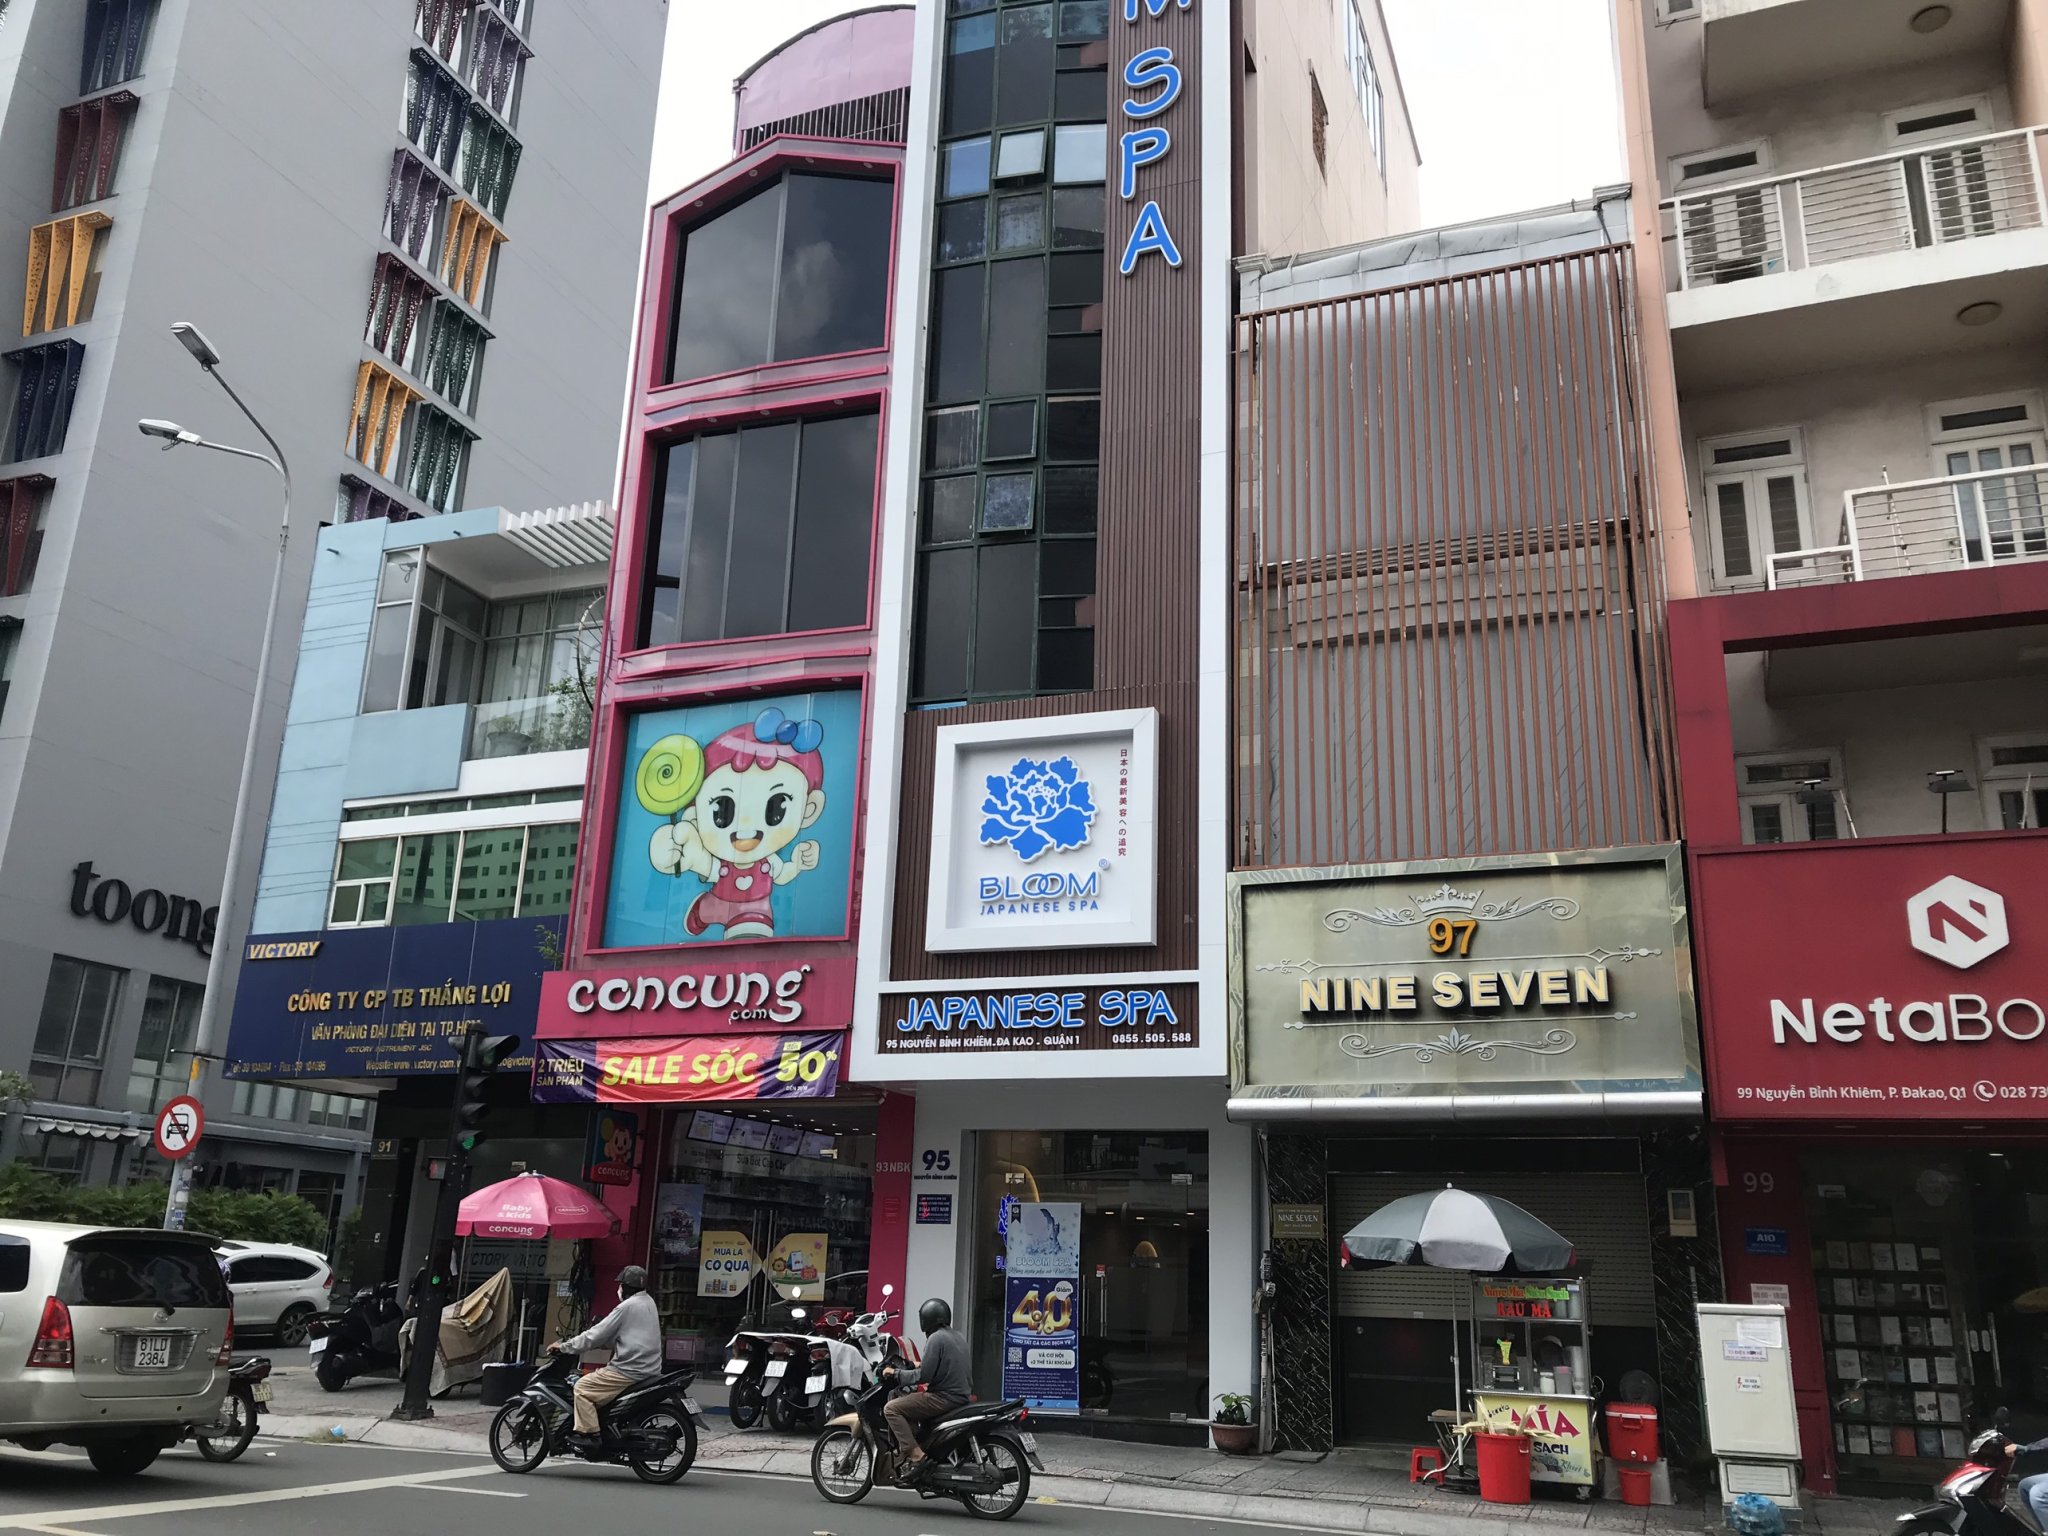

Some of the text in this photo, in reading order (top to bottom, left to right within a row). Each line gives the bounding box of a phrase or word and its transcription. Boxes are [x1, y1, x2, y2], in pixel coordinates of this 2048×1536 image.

[1120, 47, 1183, 276] SPA
[979, 871, 1098, 901] BLOOM
[980, 899, 1099, 915] JAPANESE SPA
[1428, 917, 1478, 956] 97
[249, 940, 321, 960] VICTORY
[287, 977, 511, 1012] CÔNG TY CP TB THẮNG LỢI
[567, 963, 812, 1023] concung
[1299, 966, 1610, 1012] NINE SEVEN
[896, 989, 1179, 1031] JAPANESE SPA
[311, 1022, 331, 1041] VĂN
[333, 1020, 368, 1040] PHÒNG
[885, 1039, 898, 1048] 95
[899, 1034, 937, 1048] NGUYỄN
[1012, 1036, 1034, 1046] KAO
[537, 1055, 586, 1075] 2 TRIỆU
[601, 1046, 759, 1087] SALE SỐC
[1737, 1087, 1753, 1099] 99
[1755, 1084, 1806, 1102] Nguyễn
[1840, 1086, 1885, 1101] Khiêm,
[1888, 1087, 1898, 1099] P.
[1901, 1086, 1947, 1101] Đakao,
[1949, 1087, 1966, 1100] Q1
[2000, 1086, 2027, 1098] 028
[378, 1140, 392, 1152] 91
[922, 1149, 951, 1171] 95
[1743, 1172, 1774, 1193] 99
[1296, 1214, 1318, 1222] SEVEN
[138, 1353, 166, 1366] 2384
